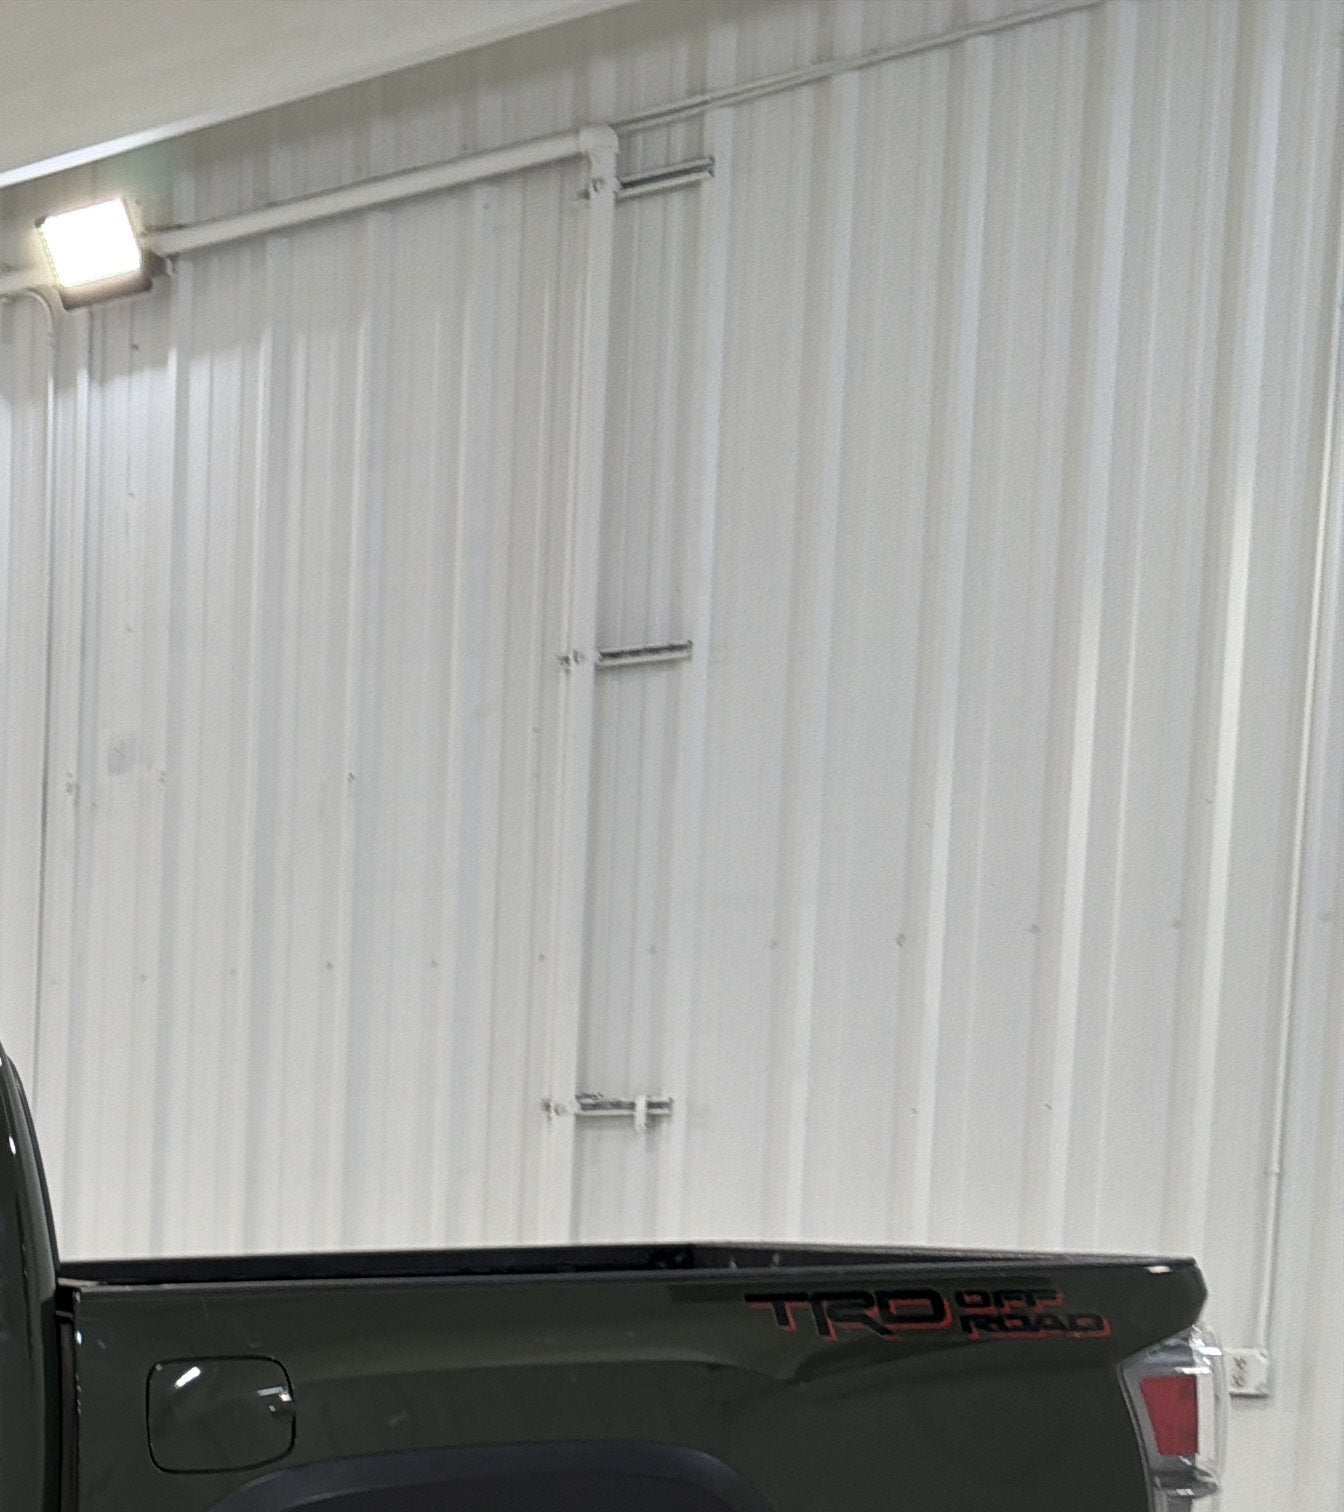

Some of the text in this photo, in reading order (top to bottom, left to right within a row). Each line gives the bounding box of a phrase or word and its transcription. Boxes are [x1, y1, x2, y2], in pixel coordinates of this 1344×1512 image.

[745, 1288, 953, 1342] TRD
[955, 1288, 1066, 1314] OFF
[958, 1312, 1111, 1341] ROAD
